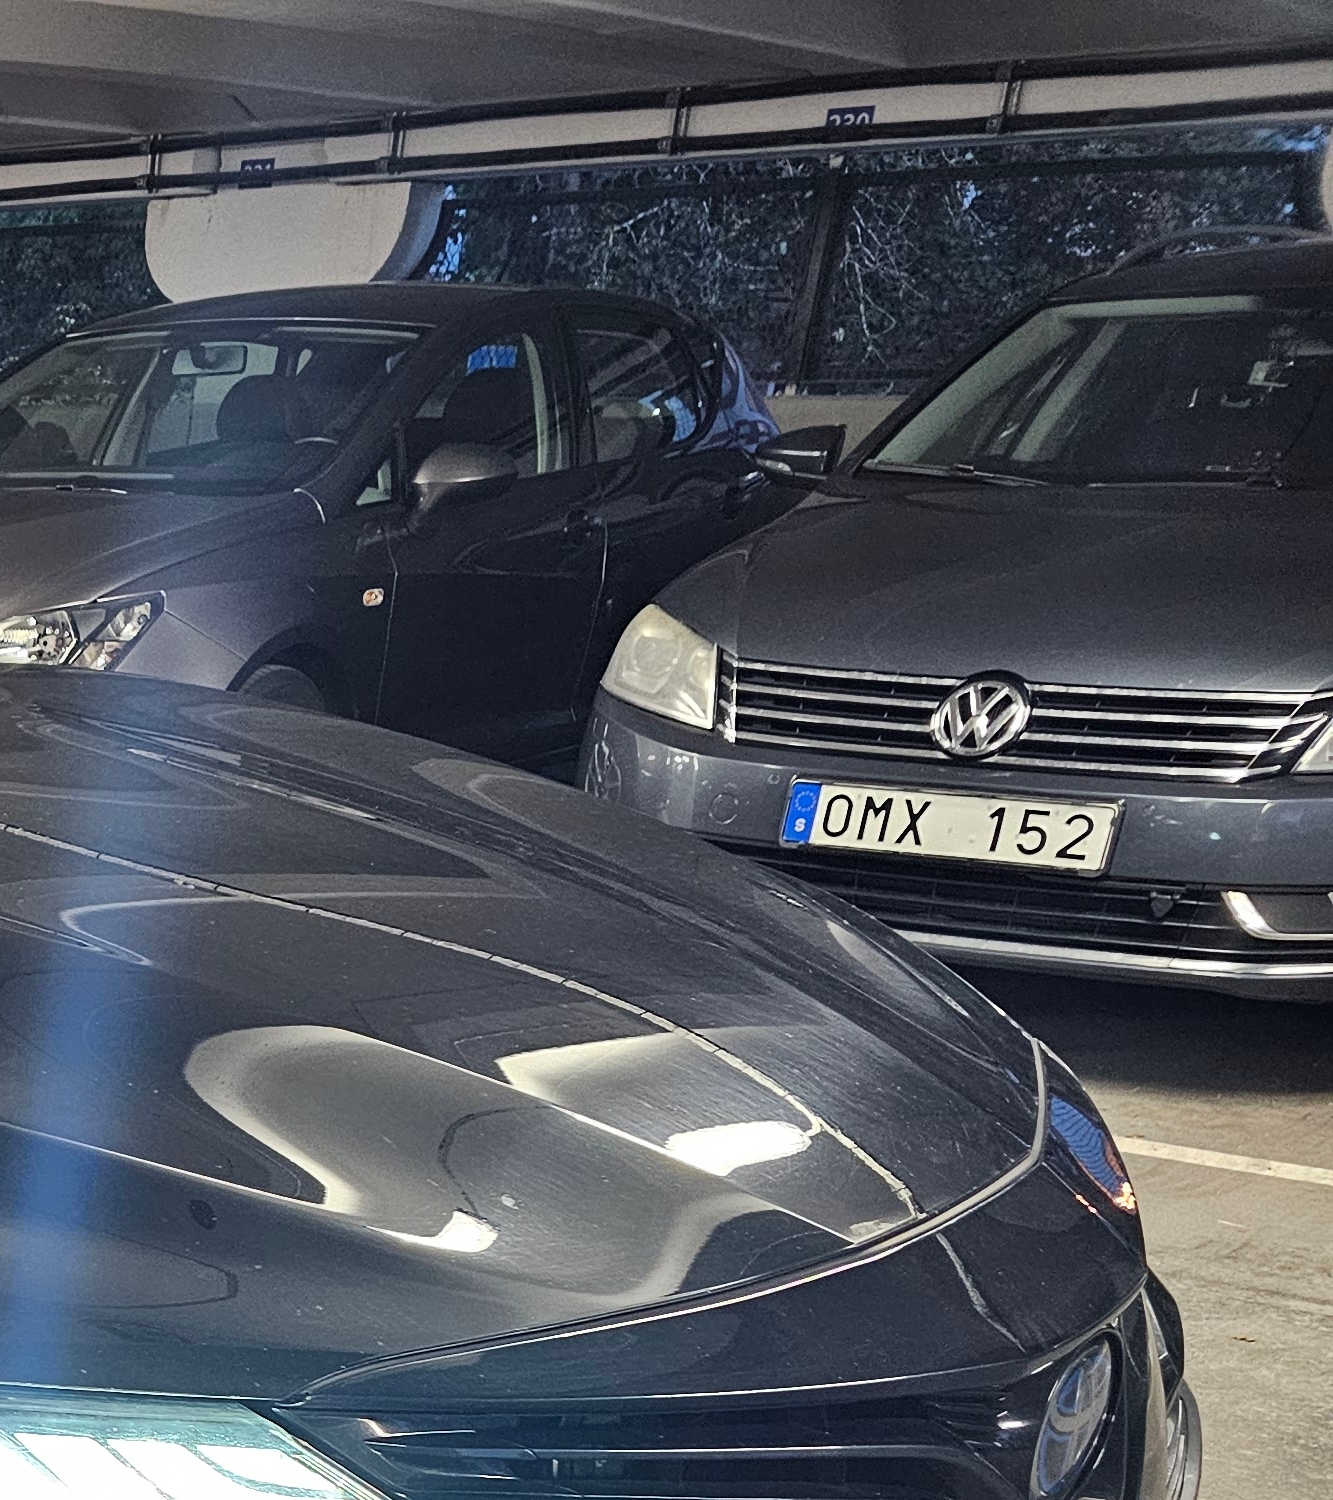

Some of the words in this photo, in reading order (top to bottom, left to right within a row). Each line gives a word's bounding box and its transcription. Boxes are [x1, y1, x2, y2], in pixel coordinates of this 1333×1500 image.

[794, 817, 806, 832] S
[822, 794, 931, 846] OMX
[988, 807, 1094, 861] 152
